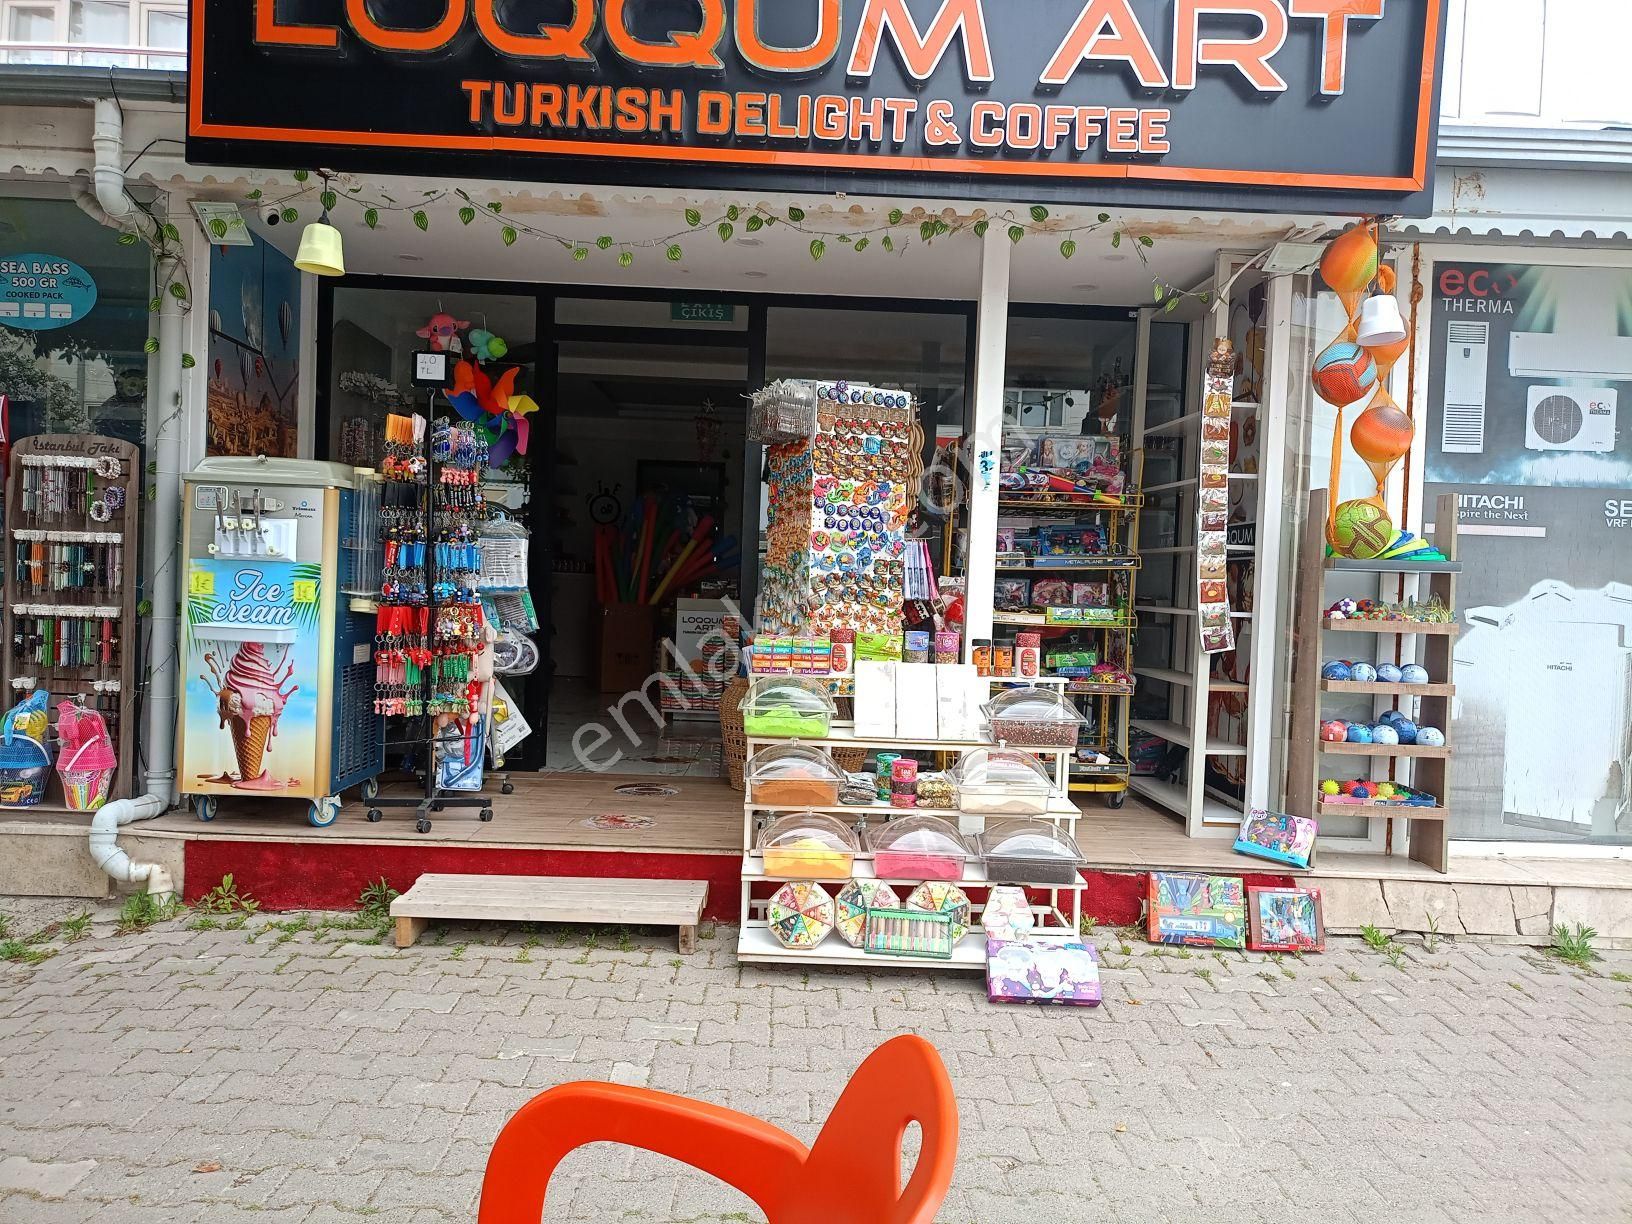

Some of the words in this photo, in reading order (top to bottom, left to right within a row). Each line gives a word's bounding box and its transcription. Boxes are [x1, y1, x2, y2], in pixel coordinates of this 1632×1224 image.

[1039, 0, 1385, 95] ART
[460, 80, 684, 134] TURKISH
[697, 90, 918, 142] DELIGHT
[925, 100, 962, 145] &
[970, 101, 1170, 153] COFFEE
[0, 261, 28, 275] SEA
[32, 262, 70, 275] BASS
[12, 277, 36, 288] 500
[40, 278, 58, 289] GR
[6, 291, 40, 299] COOKED
[42, 292, 64, 300] PACK
[1442, 298, 1514, 314] THERMA
[1484, 510, 1501, 519] the
[1504, 511, 1529, 521] Next
[1606, 518, 1628, 528] VRF
[229, 568, 286, 602] Ice
[211, 600, 296, 625] cream
